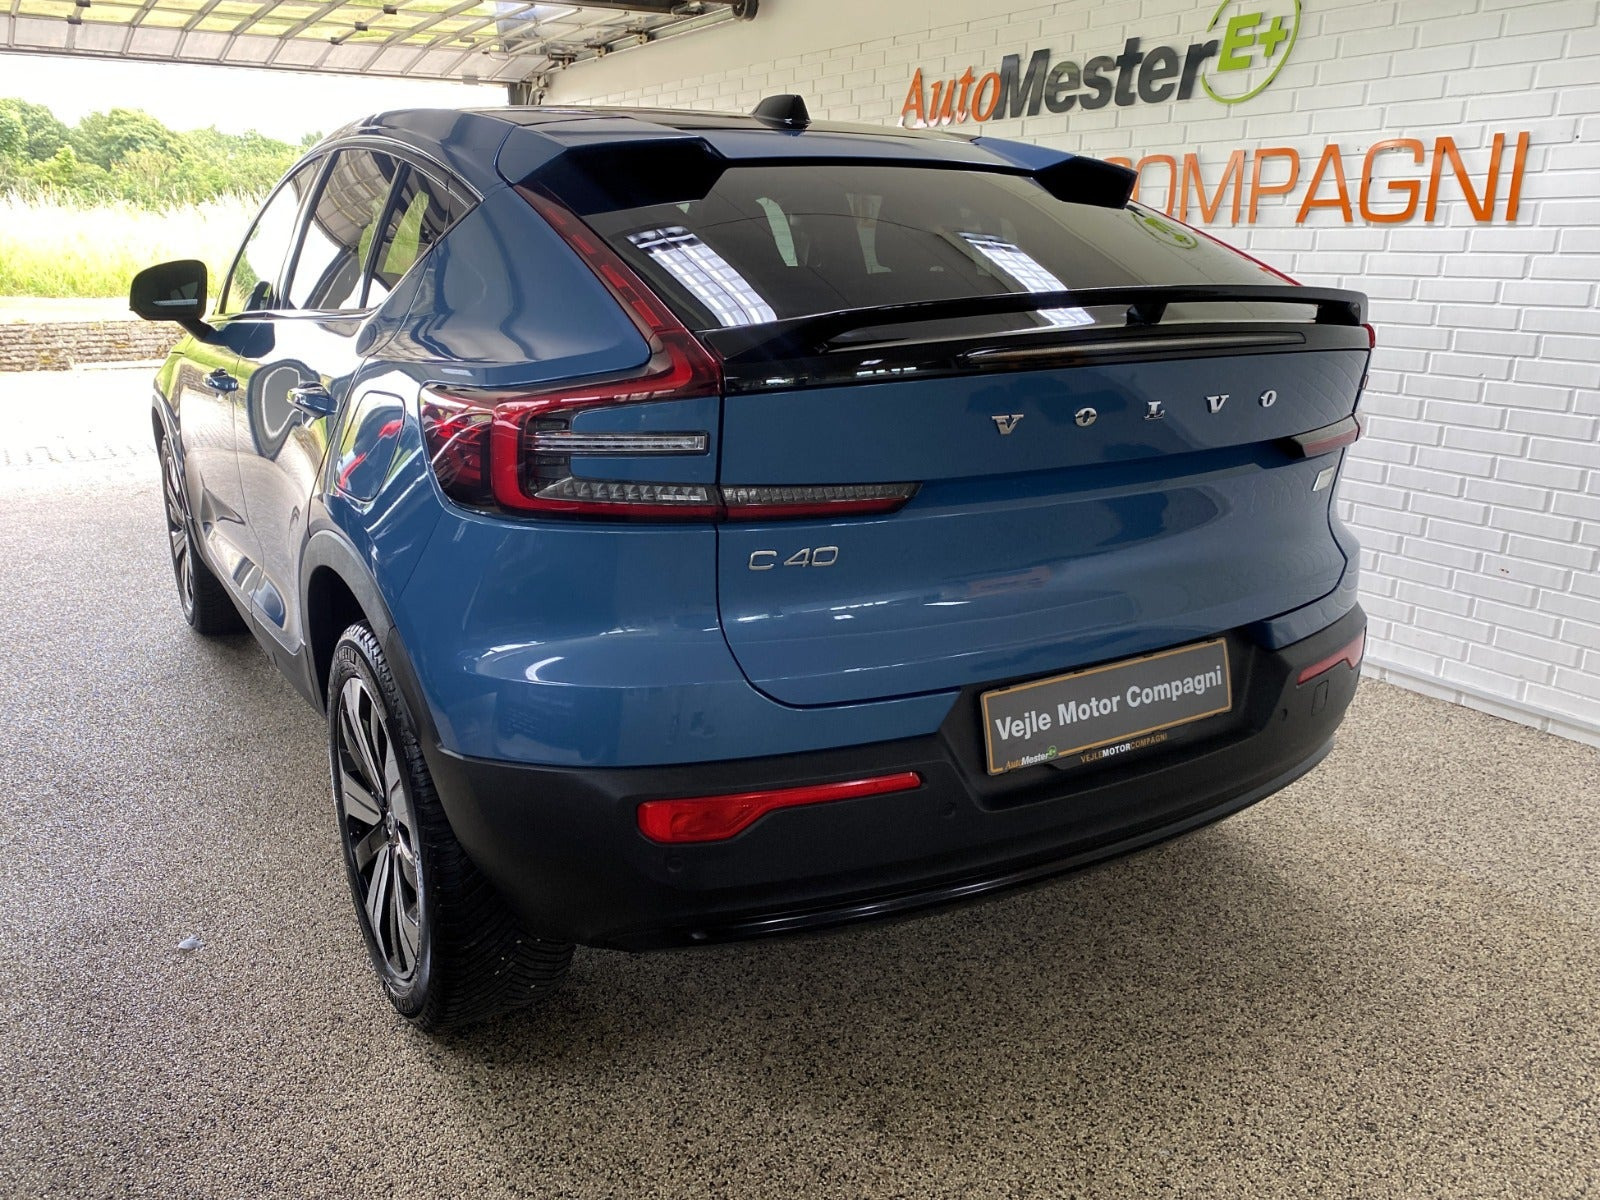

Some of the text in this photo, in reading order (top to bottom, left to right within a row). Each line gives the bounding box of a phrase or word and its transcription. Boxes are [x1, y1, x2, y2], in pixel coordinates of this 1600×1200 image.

[991, 389, 1278, 435] VOLVO
[995, 665, 1222, 740] Vejle Motor Compagni
